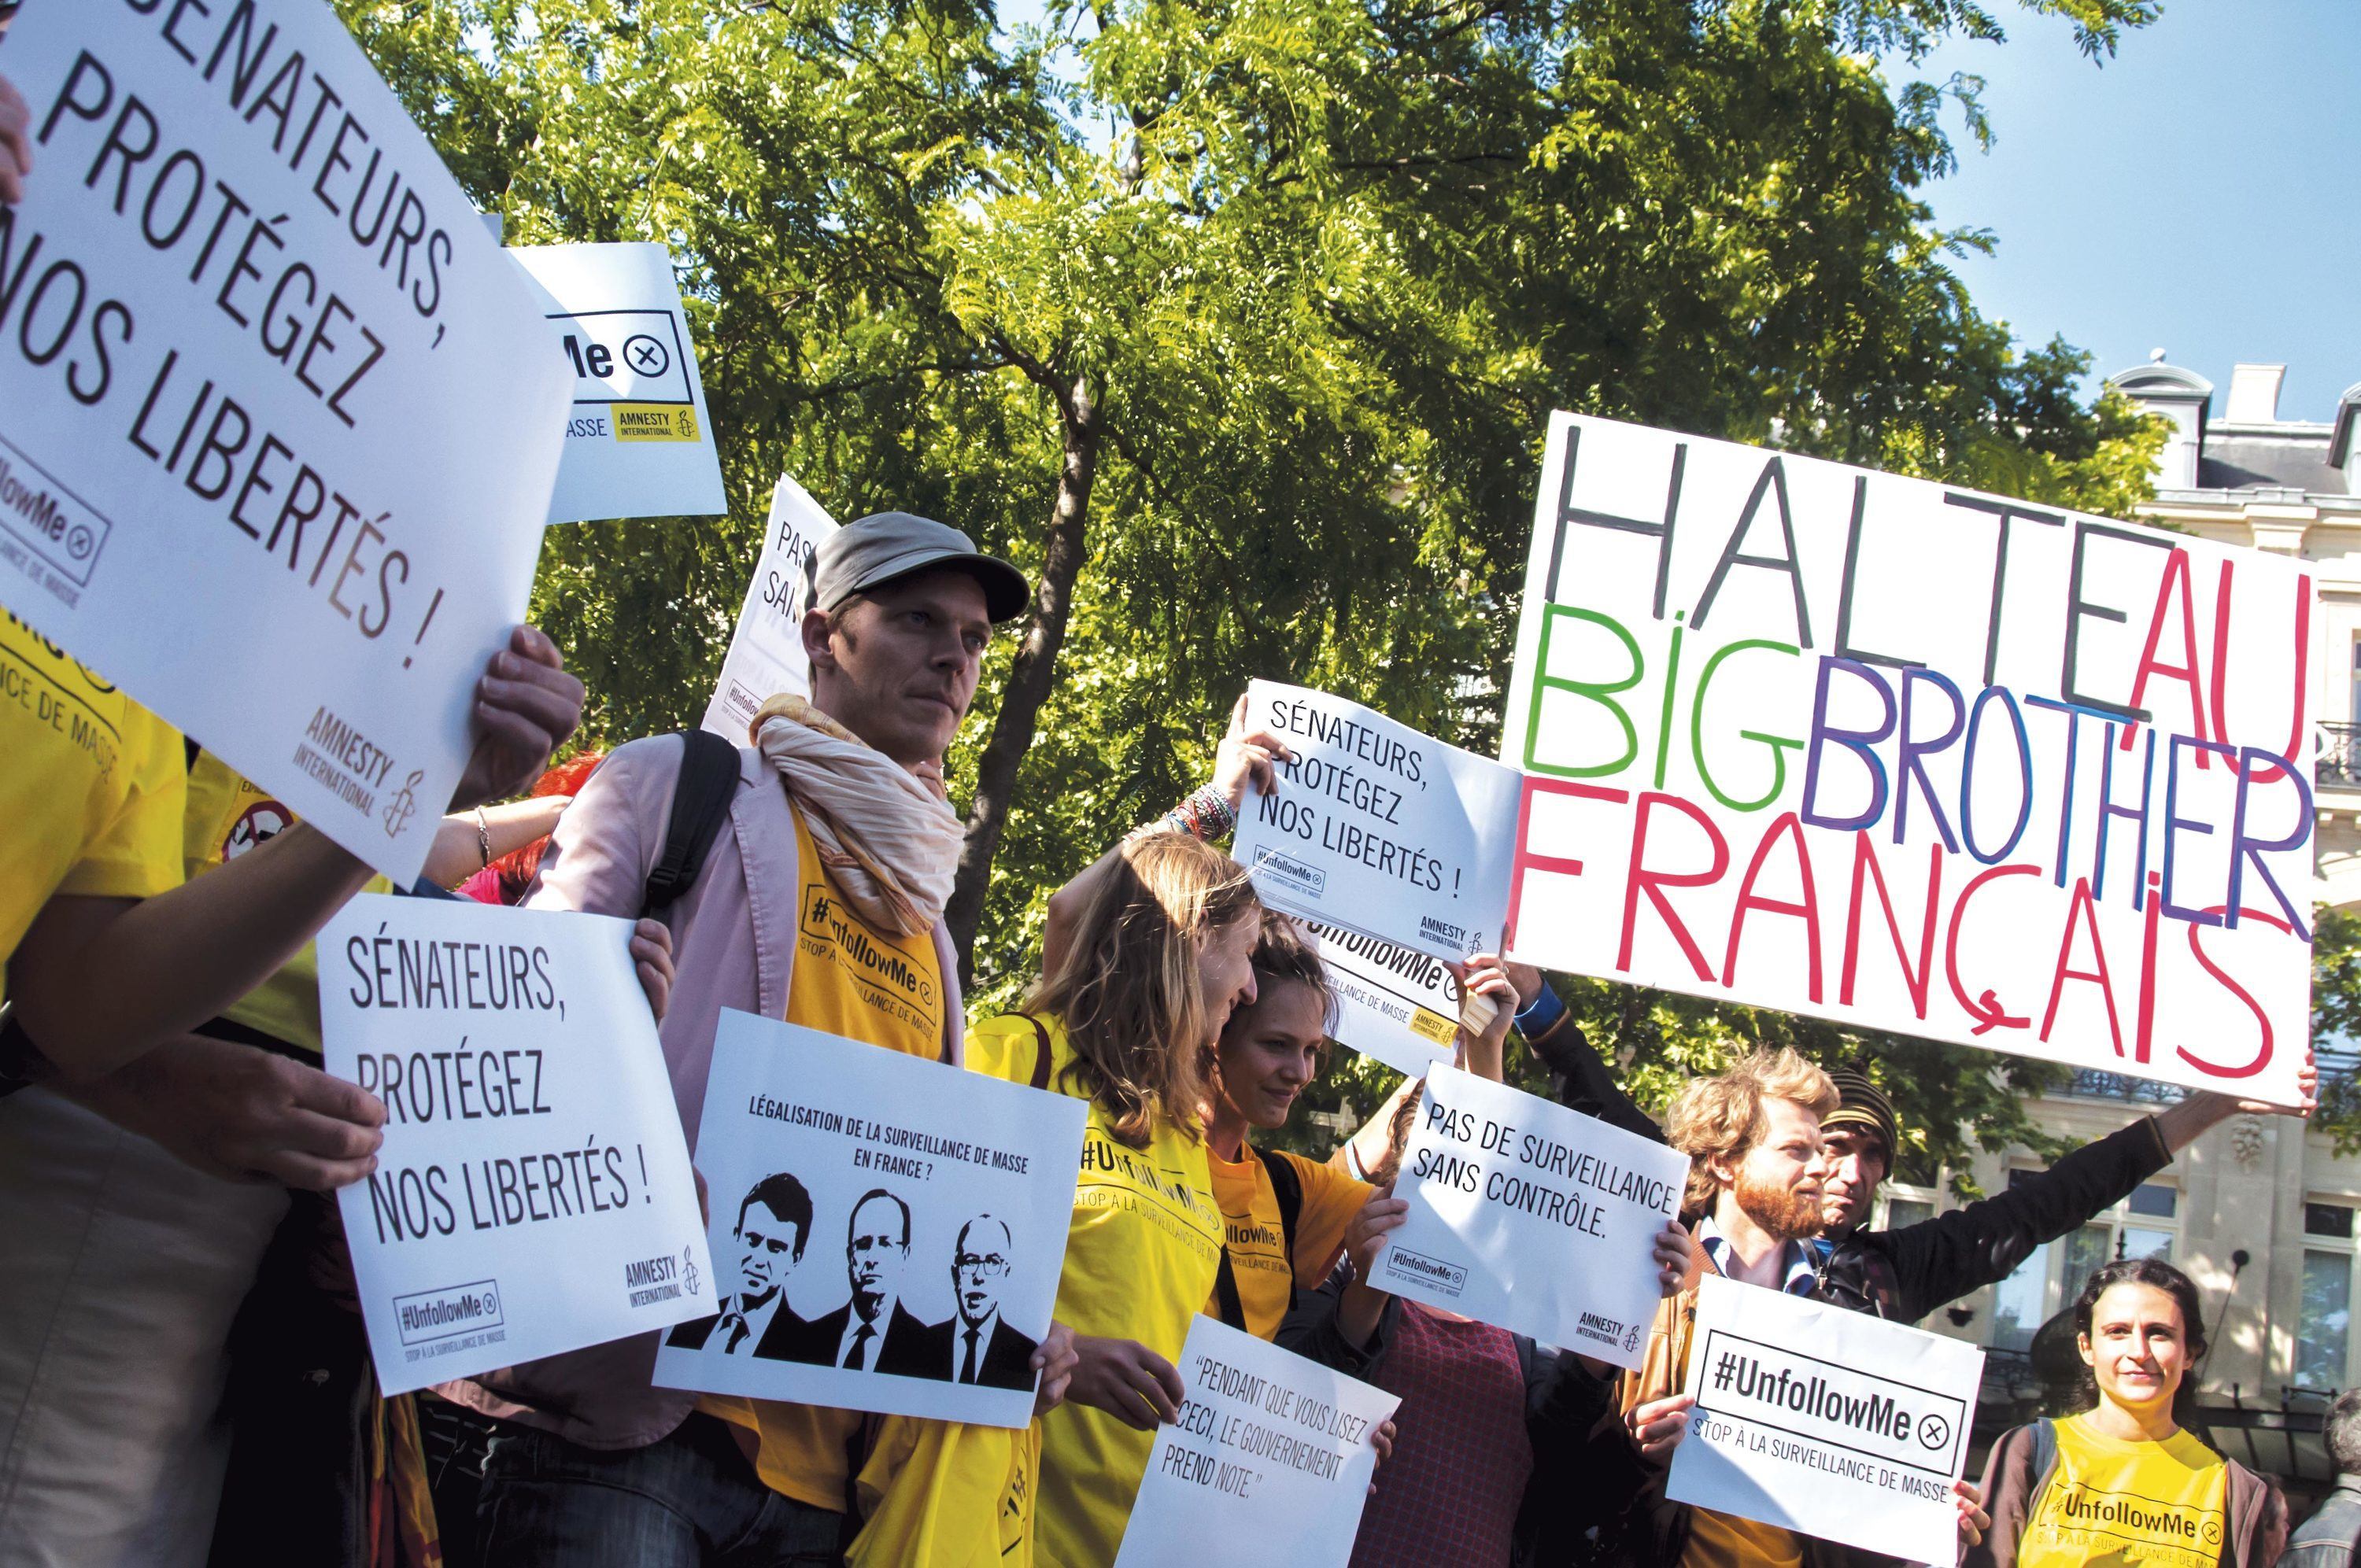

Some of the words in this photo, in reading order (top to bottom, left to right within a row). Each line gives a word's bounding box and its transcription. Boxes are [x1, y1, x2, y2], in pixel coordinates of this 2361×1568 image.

[124, 0, 452, 350] NATEURS,
[37, 49, 386, 428] PROTÉGEZ
[620, 412, 669, 426] AMNESTY
[621, 427, 673, 436] INTERNATIONAL
[127, 349, 409, 639] LIBERTÉS
[402, 587, 444, 670] !
[1545, 425, 2175, 722] HALTE
[2120, 548, 2310, 784] AU
[38, 692, 64, 733] DE
[305, 707, 394, 788] AMNESTY
[1270, 700, 1427, 791] SÉNATEURS,
[293, 743, 375, 817] INTERNATIONAL
[1271, 750, 1402, 825] ROTÉGEZ
[1801, 655, 2315, 943] BROTHER
[1259, 793, 1315, 839] NOS
[1323, 816, 1443, 891] LIBERTÉS
[1453, 868, 1461, 898] !
[812, 897, 917, 992] #nfollowMe
[1419, 929, 1463, 952] INTERNATIONAL
[1421, 916, 1466, 941] AMNESTY
[347, 921, 566, 1022] SÉNATEURS,
[800, 938, 826, 957] STOP
[898, 1005, 910, 1023] DE
[911, 1015, 934, 1042] MASSE
[1368, 994, 1380, 1009] DE
[1380, 1002, 1409, 1024] MASSE
[1417, 1013, 1443, 1032] AMNESTY
[357, 1036, 552, 1125] PROTÉGEZ
[749, 1094, 843, 1134] LÉGALISATION
[846, 1118, 863, 1138] DE
[866, 1122, 881, 1142] LA
[884, 1127, 971, 1161] SURVEILLANCE
[974, 1146, 988, 1166] DE
[992, 1151, 1029, 1175] MASSE
[854, 1149, 870, 1168] EN
[874, 1153, 922, 1179] FRANCE
[926, 1164, 933, 1180] ?
[1426, 1102, 1475, 1142] PAS
[1480, 1120, 1516, 1157] DE
[1520, 1134, 1676, 1215] SURVEILLANCE
[367, 1165, 456, 1244] NOS
[462, 1134, 629, 1230] LIBERTÉS
[637, 1144, 651, 1204] !
[1081, 1141, 1200, 1216] #UnfollowM
[1124, 1197, 1138, 1213] LA
[1413, 1148, 1480, 1193] SANS
[1487, 1172, 1606, 1239] CONTRÔLE.
[626, 1255, 676, 1288] AMNESTY
[1226, 1223, 1277, 1247] llowMe
[1393, 1252, 1451, 1280] #UnfollowMe
[402, 1295, 482, 1330] #UnfollowMe
[630, 1283, 682, 1308] INTERNATIONAL
[1580, 1312, 1624, 1336] AMNESTY
[435, 1338, 477, 1356] SURVEILLANCE
[486, 1330, 506, 1345] MASSE
[1576, 1326, 1618, 1346] INTERNATIONAL
[1265, 1385, 1295, 1419] QUE
[1293, 1394, 1330, 1432] VOUS
[1328, 1409, 1368, 1445] LISEZ
[1714, 1352, 1912, 1441] #UnfollowMe
[1162, 1444, 1215, 1486] PREND
[1175, 1400, 1217, 1445] CECI,
[1220, 1415, 1242, 1447] LE
[1240, 1422, 1343, 1481] GOUVERNEMENT
[1692, 1418, 1732, 1443] STOP
[1735, 1426, 1745, 1448] À
[1750, 1433, 1767, 1453] LA
[1771, 1439, 1875, 1484] SURVEILLANCE
[1879, 1469, 1899, 1490] DE
[1901, 1475, 1949, 1503] MASSE
[2052, 1493, 2196, 1538] #UnfollowMe
[2178, 1554, 2192, 1566] DE
